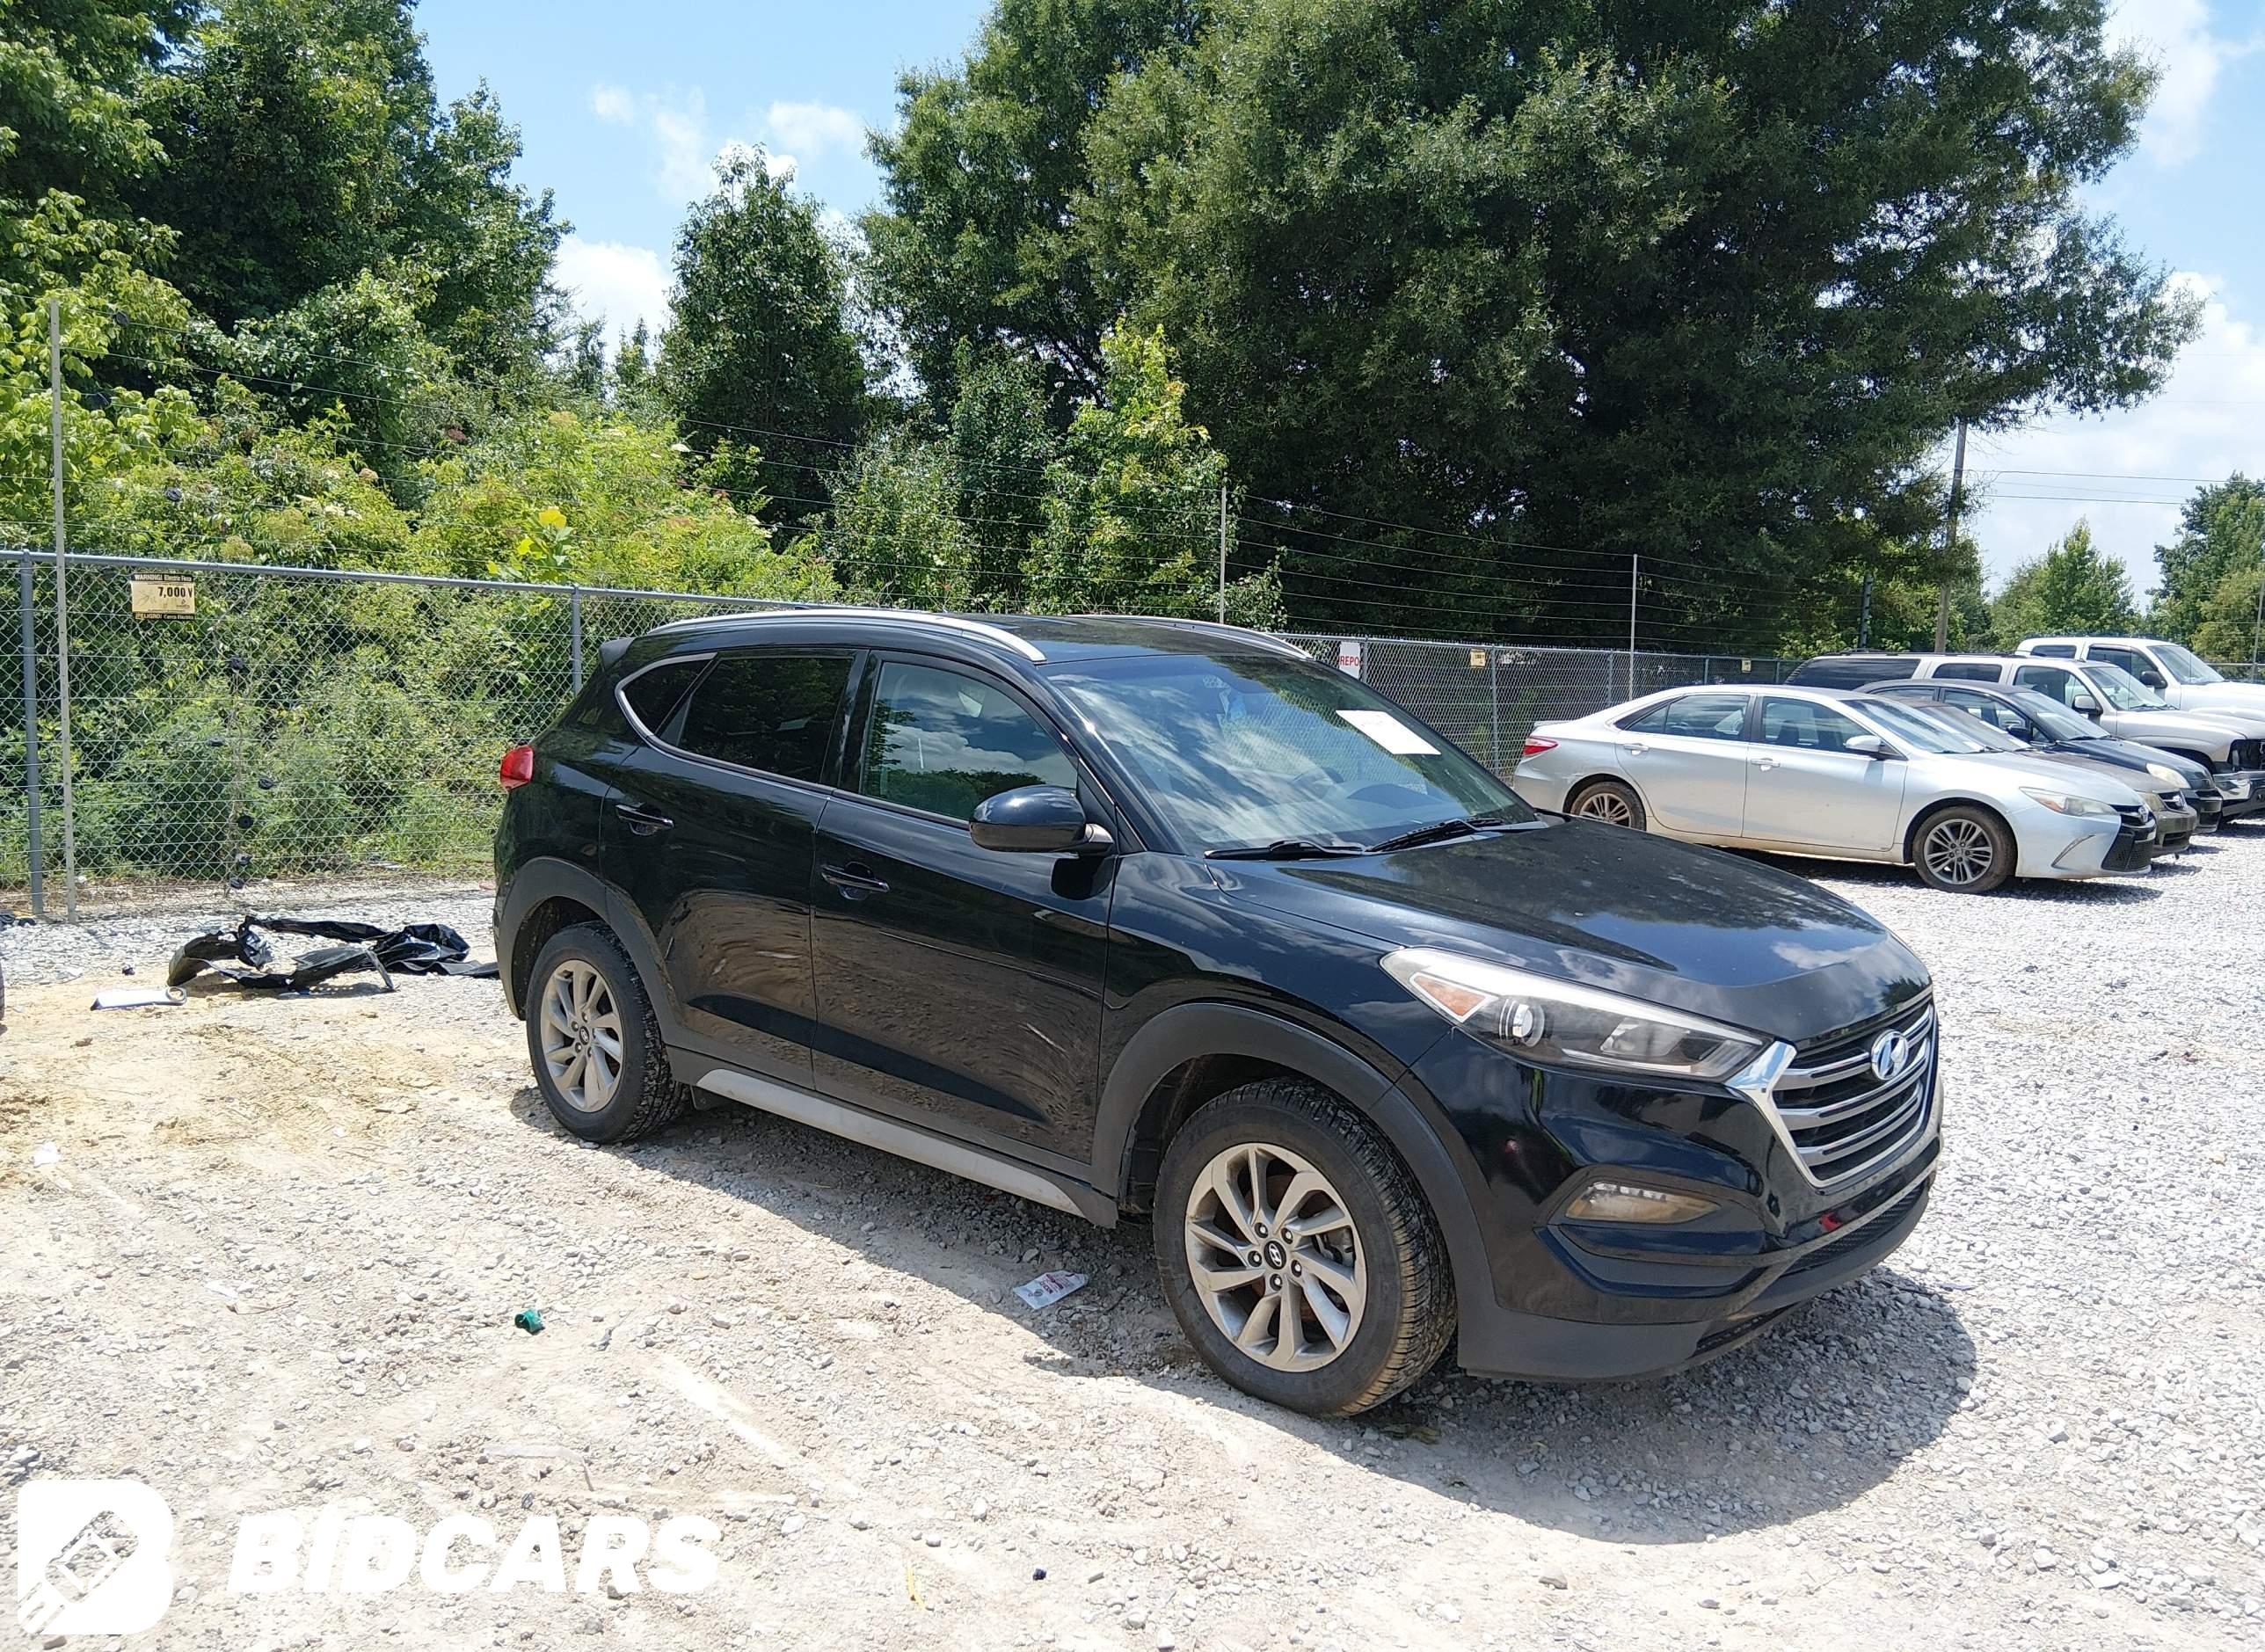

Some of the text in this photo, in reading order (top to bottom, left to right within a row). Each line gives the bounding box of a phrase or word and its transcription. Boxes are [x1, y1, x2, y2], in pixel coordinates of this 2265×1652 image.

[157, 586, 193, 599] 7,000 V
[1340, 655, 1360, 667] REPO
